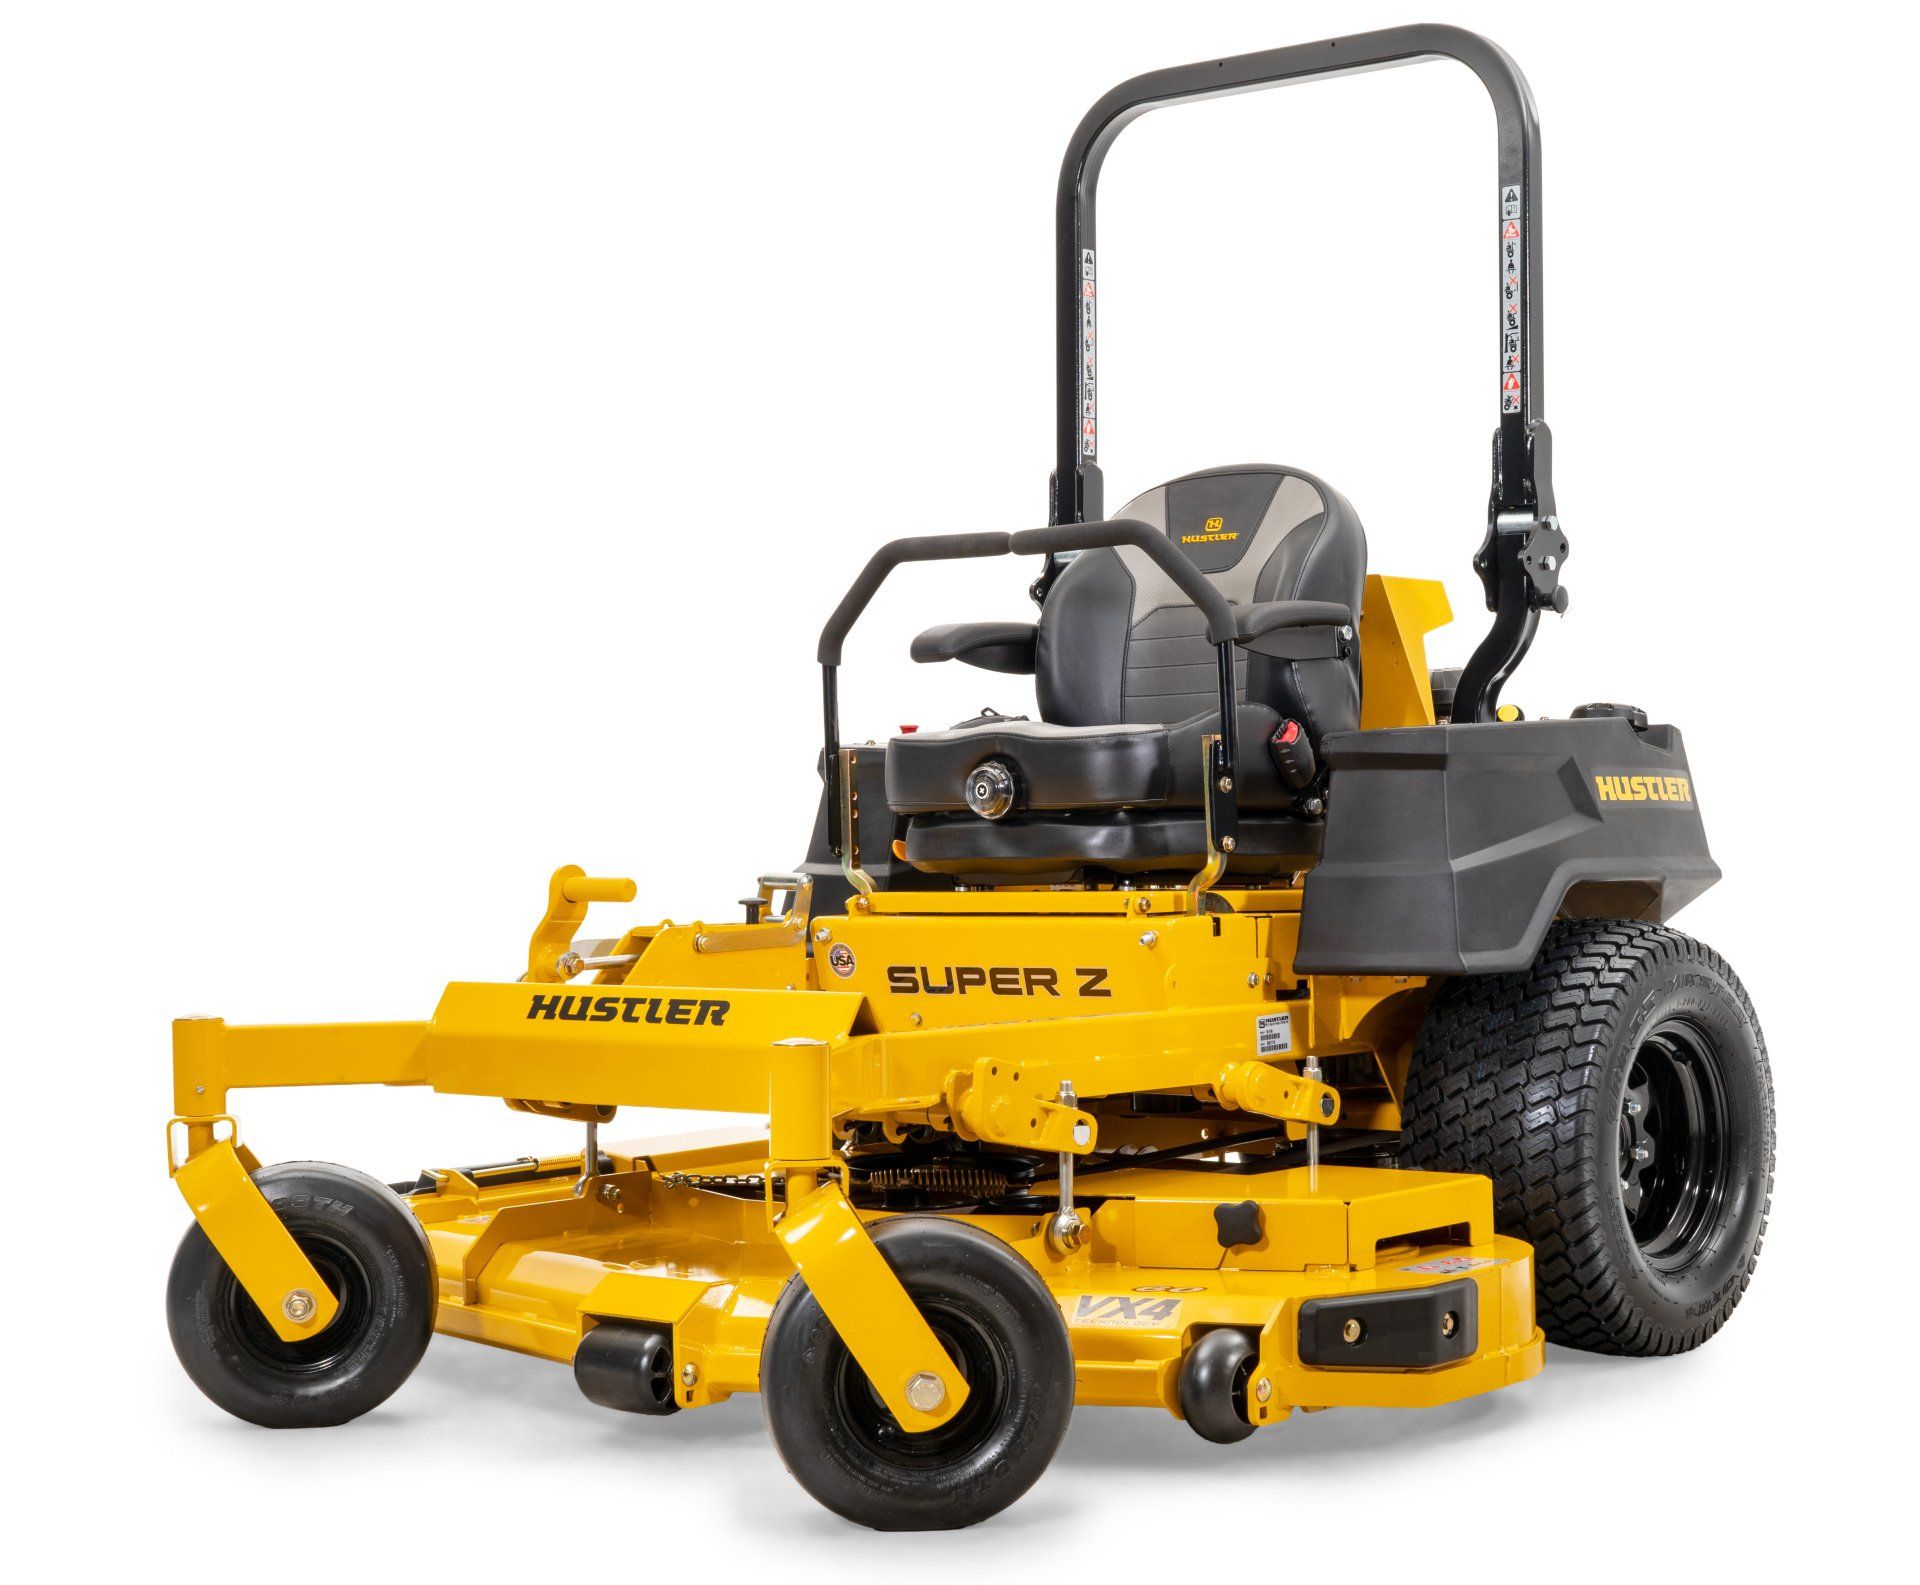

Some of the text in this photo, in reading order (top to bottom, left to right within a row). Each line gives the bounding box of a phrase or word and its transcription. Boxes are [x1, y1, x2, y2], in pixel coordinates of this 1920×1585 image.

[1181, 532, 1237, 543] HUSTLER
[1595, 776, 1691, 801] HUSTLER
[830, 955, 855, 966] USA
[887, 966, 1112, 996] SUPER Z
[526, 994, 731, 1026] HUSTLER
[1076, 1295, 1182, 1321] VX4
[1073, 1318, 1162, 1327] TECHNOLOGY
